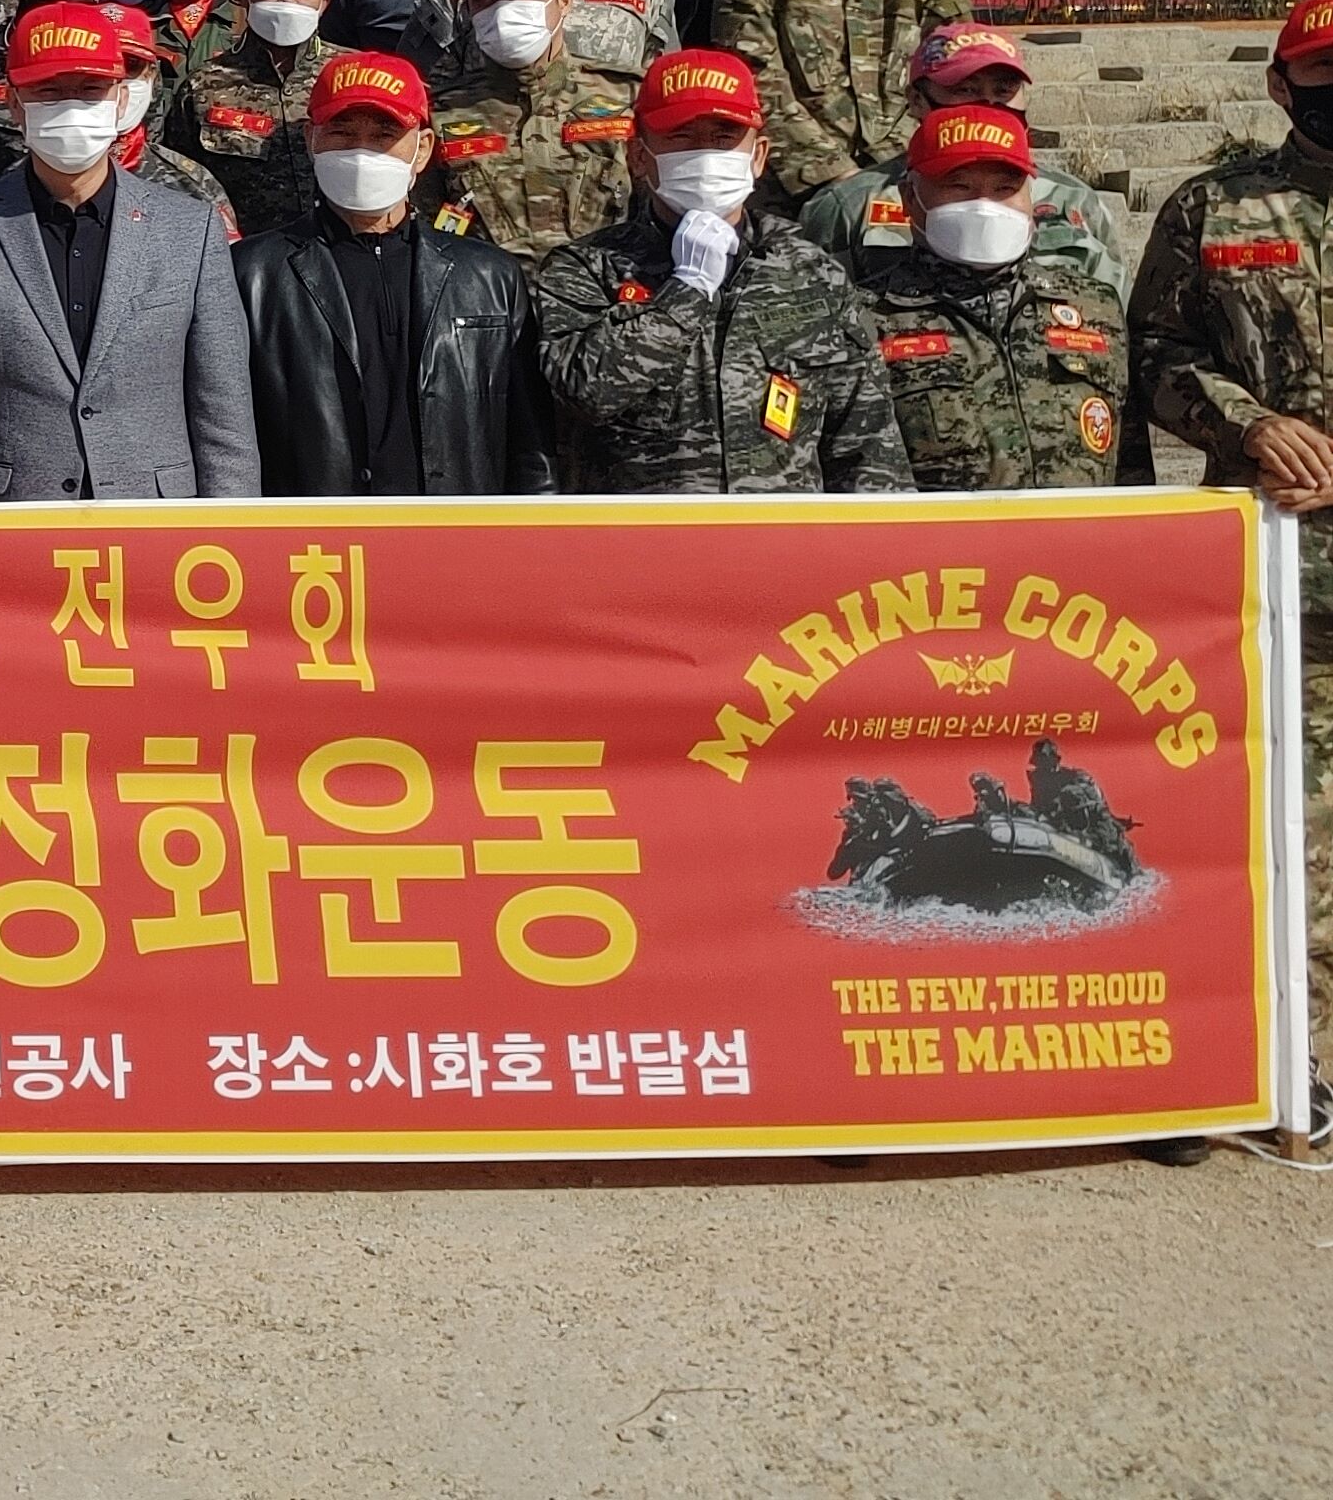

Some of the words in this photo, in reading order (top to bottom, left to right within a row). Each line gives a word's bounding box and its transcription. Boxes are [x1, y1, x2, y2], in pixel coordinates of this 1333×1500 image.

[29, 27, 101, 56] ROKMC
[332, 67, 405, 96] ROKMC
[661, 67, 739, 97] ROKMC
[938, 122, 1015, 149] ROKMC
[50, 544, 375, 692] 전우회
[686, 567, 986, 783] MARINE
[1003, 574, 1219, 769] CORPS
[822, 709, 1100, 741] 사)해병대안산시전우회
[831, 978, 902, 1015] THE
[1066, 970, 1167, 1008] PROUD
[567, 1029, 752, 1097] 반달섬
[842, 1028, 945, 1076] THE
[953, 1018, 1173, 1074] MARINES
